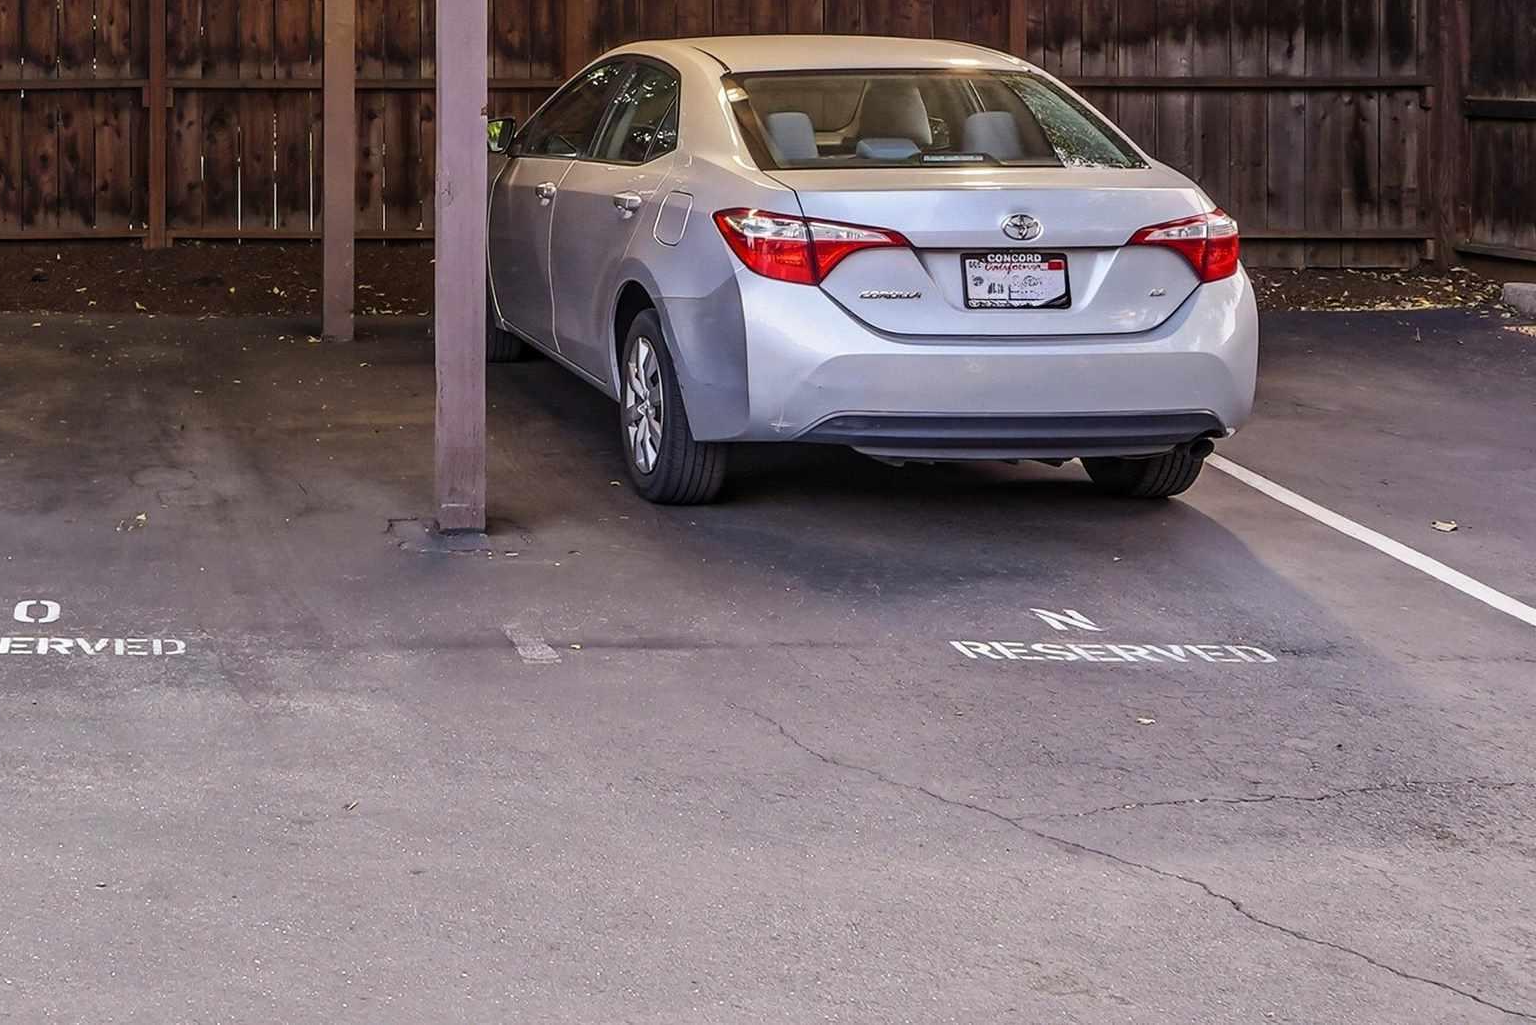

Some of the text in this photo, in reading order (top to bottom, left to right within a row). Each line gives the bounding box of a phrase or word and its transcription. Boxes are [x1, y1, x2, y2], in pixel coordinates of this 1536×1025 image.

[986, 254, 1042, 263] CONCORD
[1029, 607, 1103, 632] N
[948, 640, 1279, 664] RESERVED
